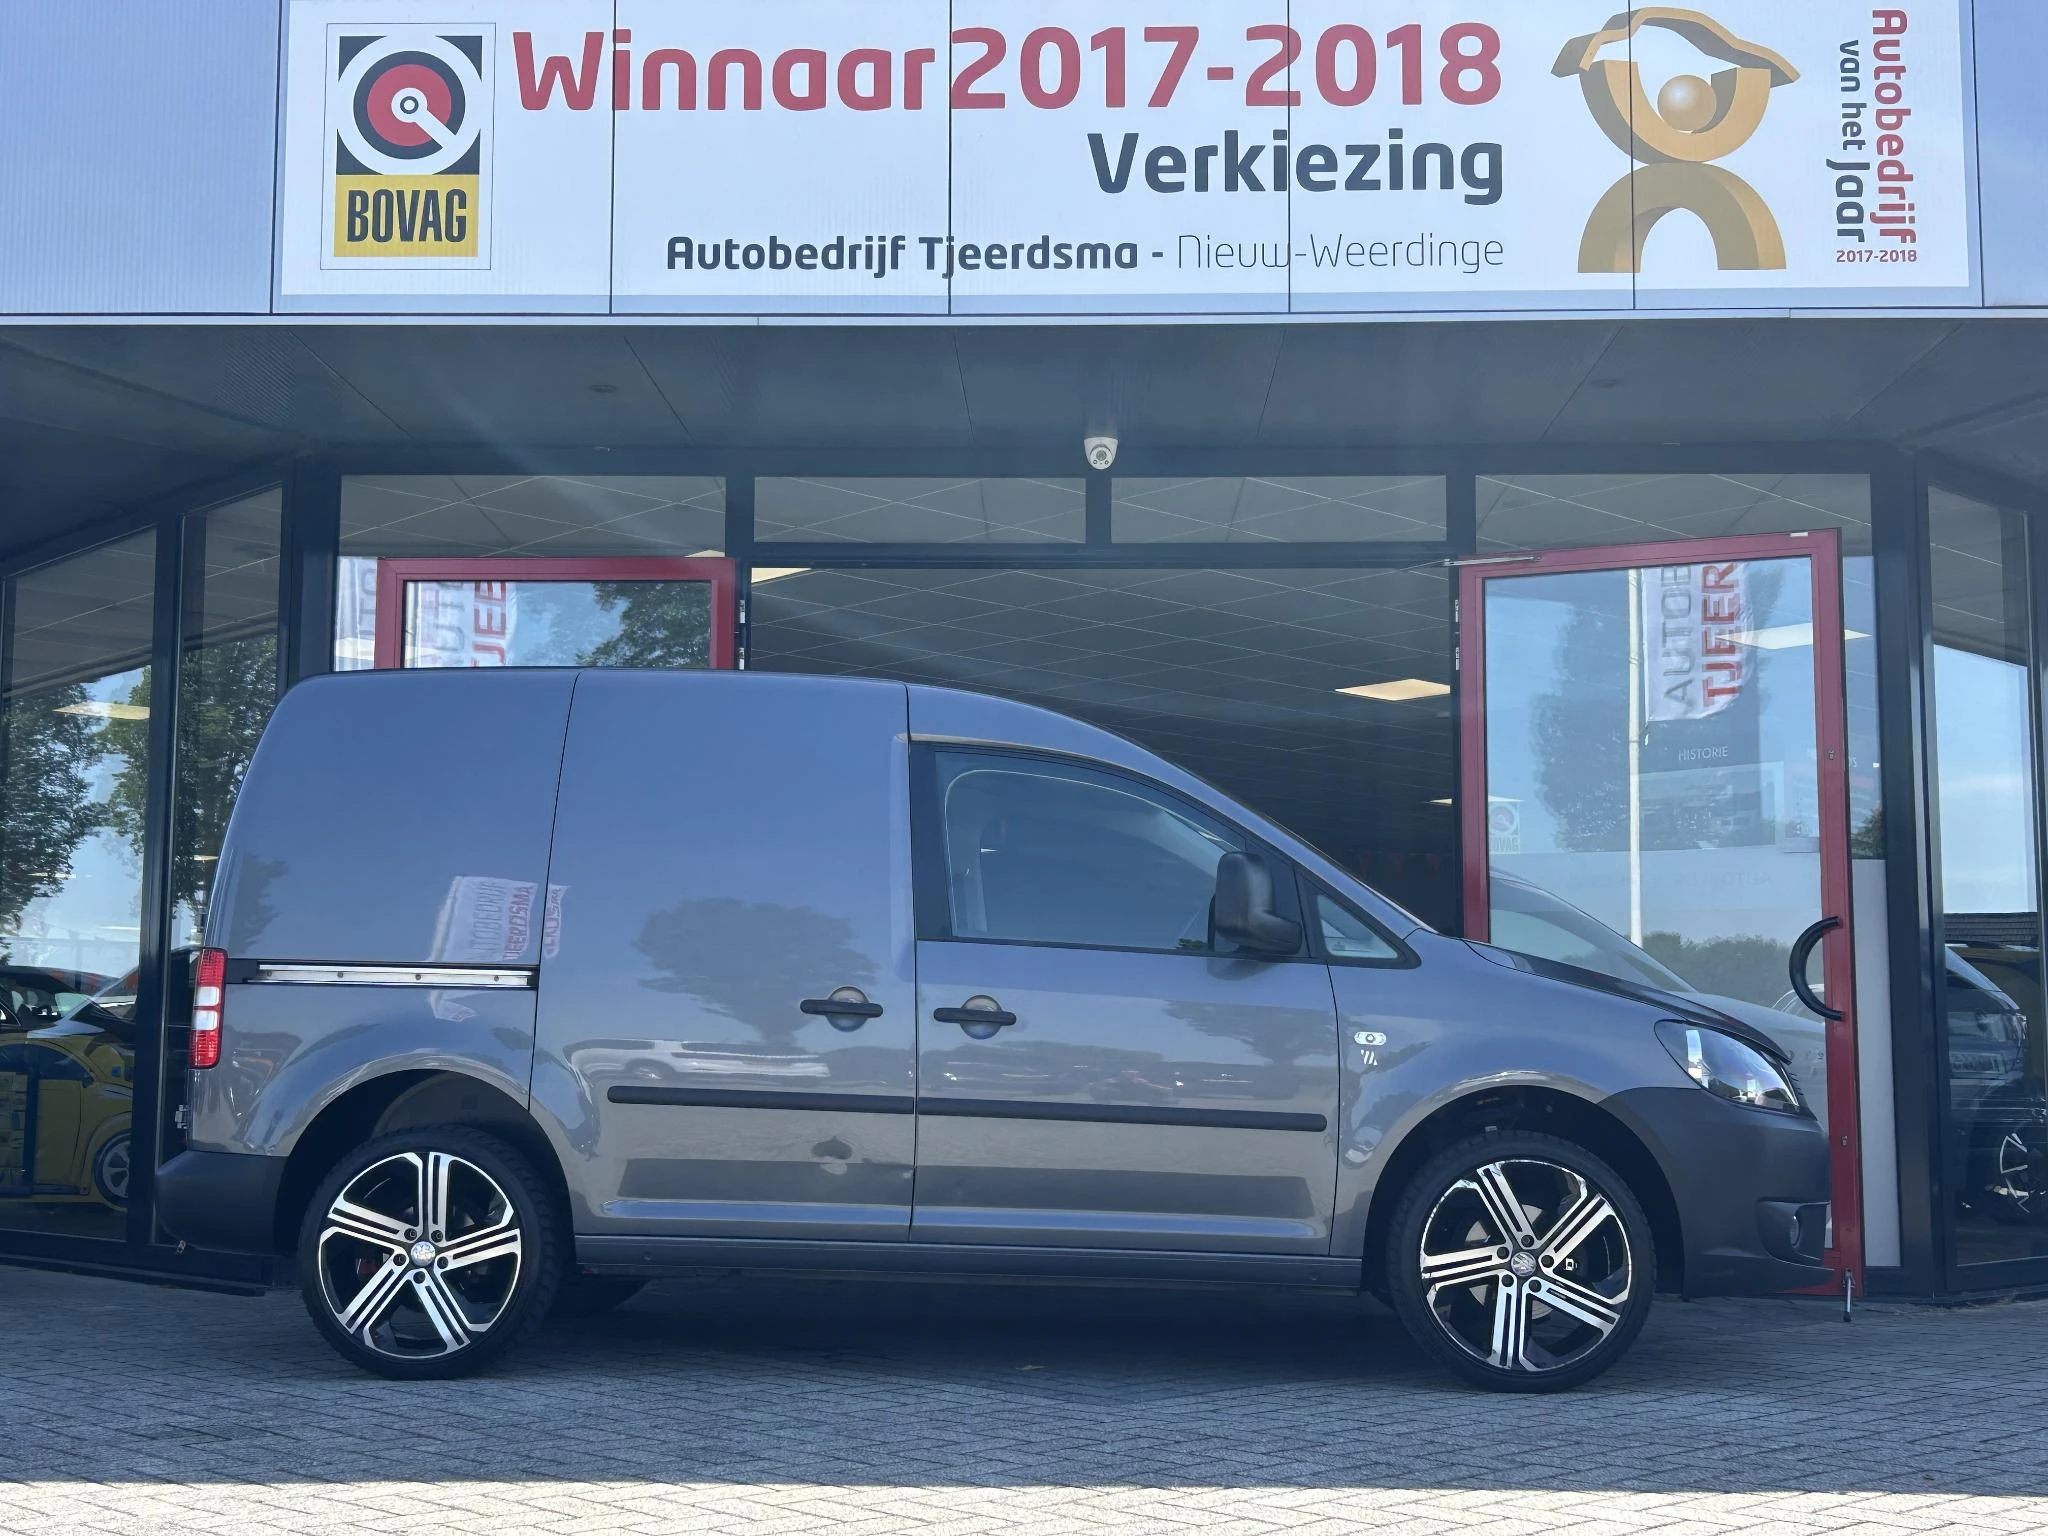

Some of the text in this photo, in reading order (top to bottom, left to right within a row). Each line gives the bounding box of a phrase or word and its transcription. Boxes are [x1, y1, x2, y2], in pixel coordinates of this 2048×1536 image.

[513, 22, 1502, 111] Winnaar 2017-2018
[1840, 39, 1861, 92] van
[1841, 103, 1867, 151] het
[1870, 9, 1917, 243] Autobedrijf
[1087, 128, 1503, 206] Verkiezing
[347, 188, 468, 243] BOVAG
[667, 235, 907, 279] Autobedrijf
[918, 235, 1139, 279] Tjeerdsma
[1177, 232, 1505, 274] Nieuw-Weerdinge
[1836, 249, 1918, 264] 2017-2018
[1678, 745, 1729, 761] HISTORIE
